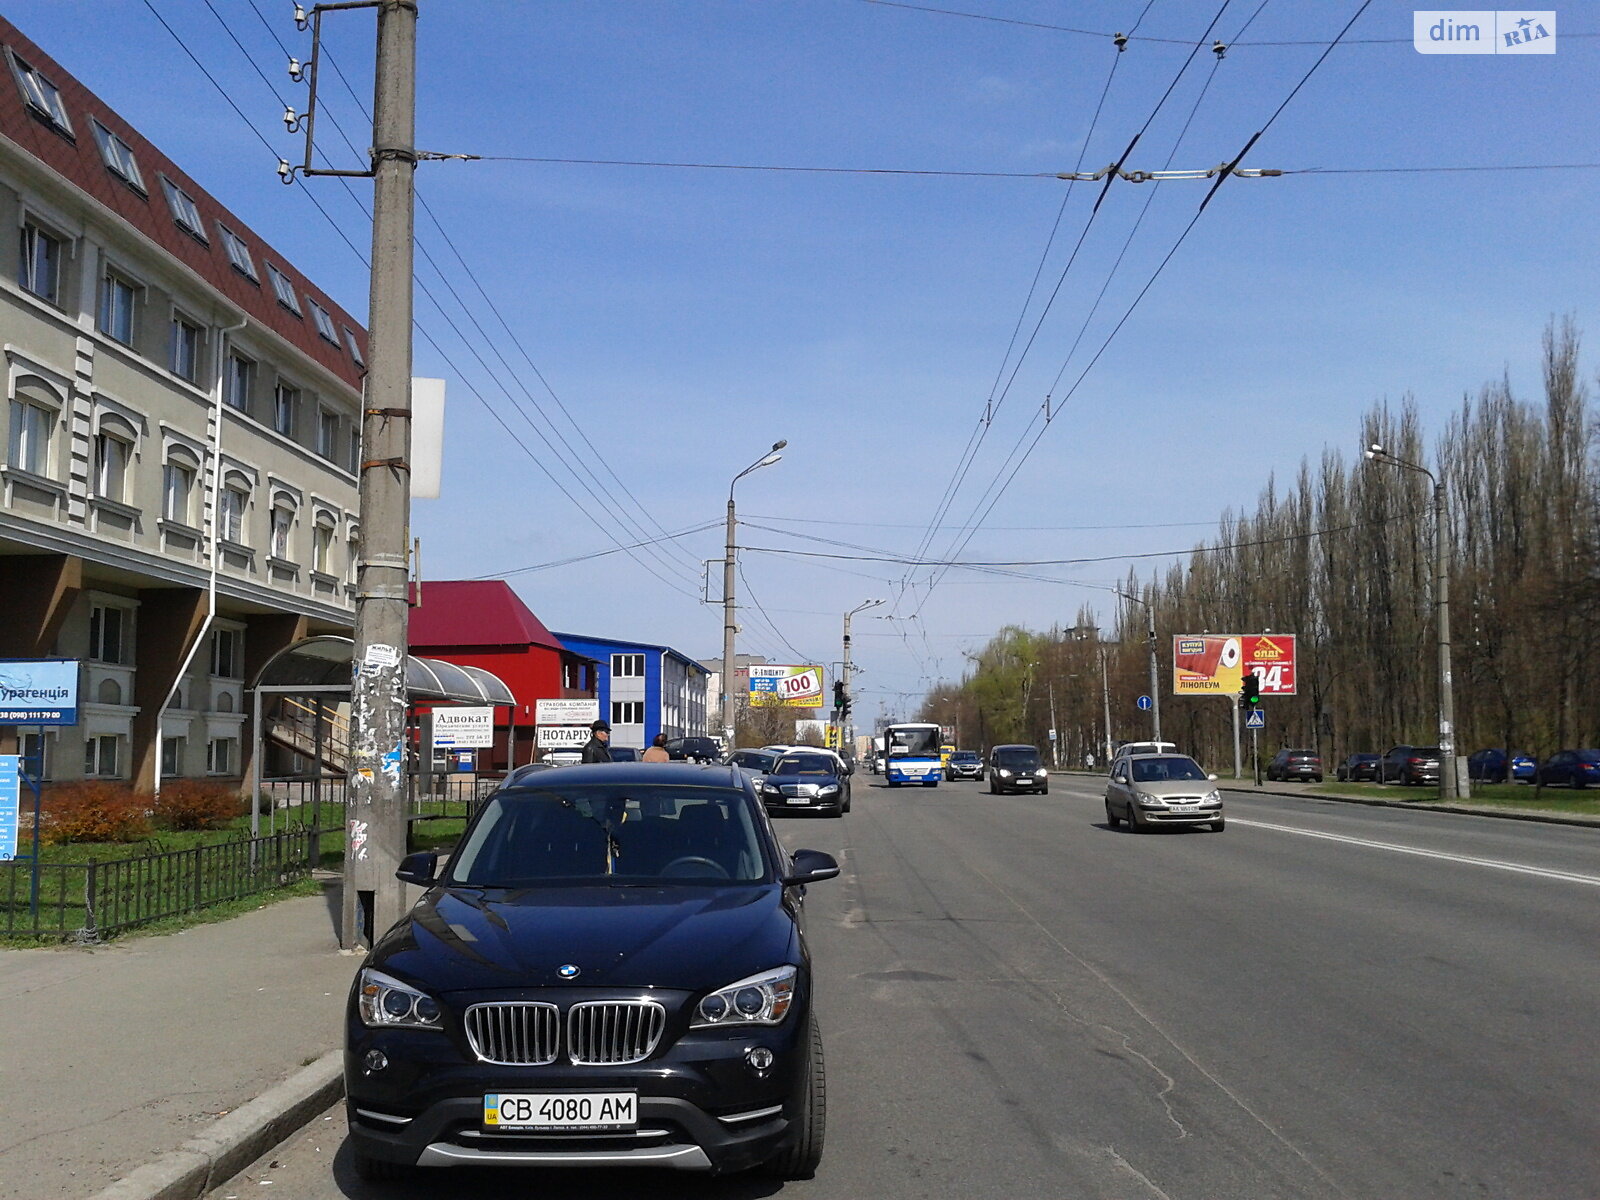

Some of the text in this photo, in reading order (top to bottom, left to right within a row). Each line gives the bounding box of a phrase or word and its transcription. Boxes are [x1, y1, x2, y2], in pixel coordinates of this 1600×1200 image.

[784, 675, 811, 692] 100
[1180, 681, 1220, 689] ЛІНОЛЕУМ
[0, 685, 69, 701] урагенція
[10, 711, 28, 720] (098)
[29, 711, 41, 719] 111
[42, 711, 51, 719] 79
[51, 711, 61, 719] 00
[437, 713, 489, 724] Адвокат
[500, 1097, 632, 1121] CB 4080 AM
